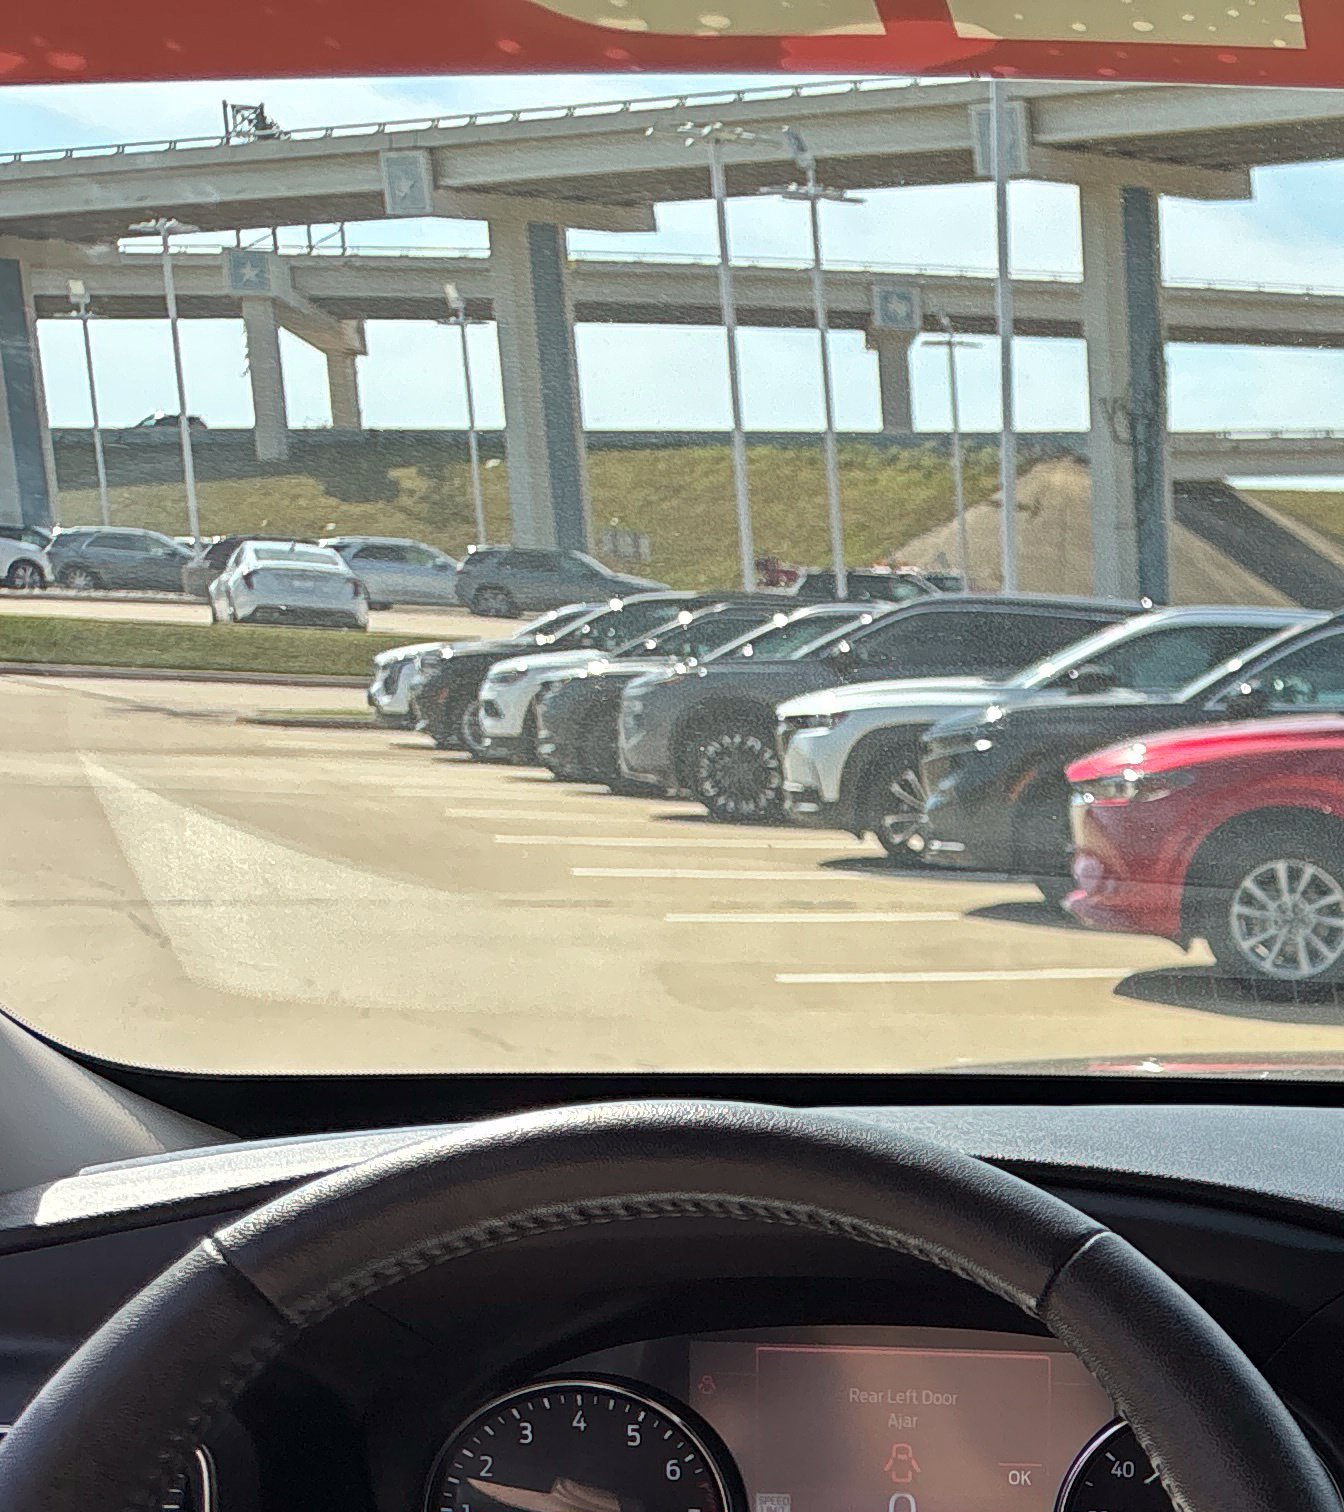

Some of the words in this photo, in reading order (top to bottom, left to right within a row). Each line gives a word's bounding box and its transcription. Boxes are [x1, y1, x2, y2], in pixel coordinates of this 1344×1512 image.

[850, 1388, 884, 1403] Rear
[888, 1389, 918, 1405] Left
[922, 1390, 958, 1406] Door
[572, 1411, 587, 1432] 4
[888, 1413, 919, 1429] Ajar
[519, 1422, 534, 1444] 3
[627, 1426, 641, 1447] 5
[479, 1456, 493, 1477] 2
[665, 1461, 681, 1481] 6
[1110, 1460, 1135, 1478] 40
[1008, 1470, 1032, 1486] OK
[758, 1496, 791, 1505] SPEED
